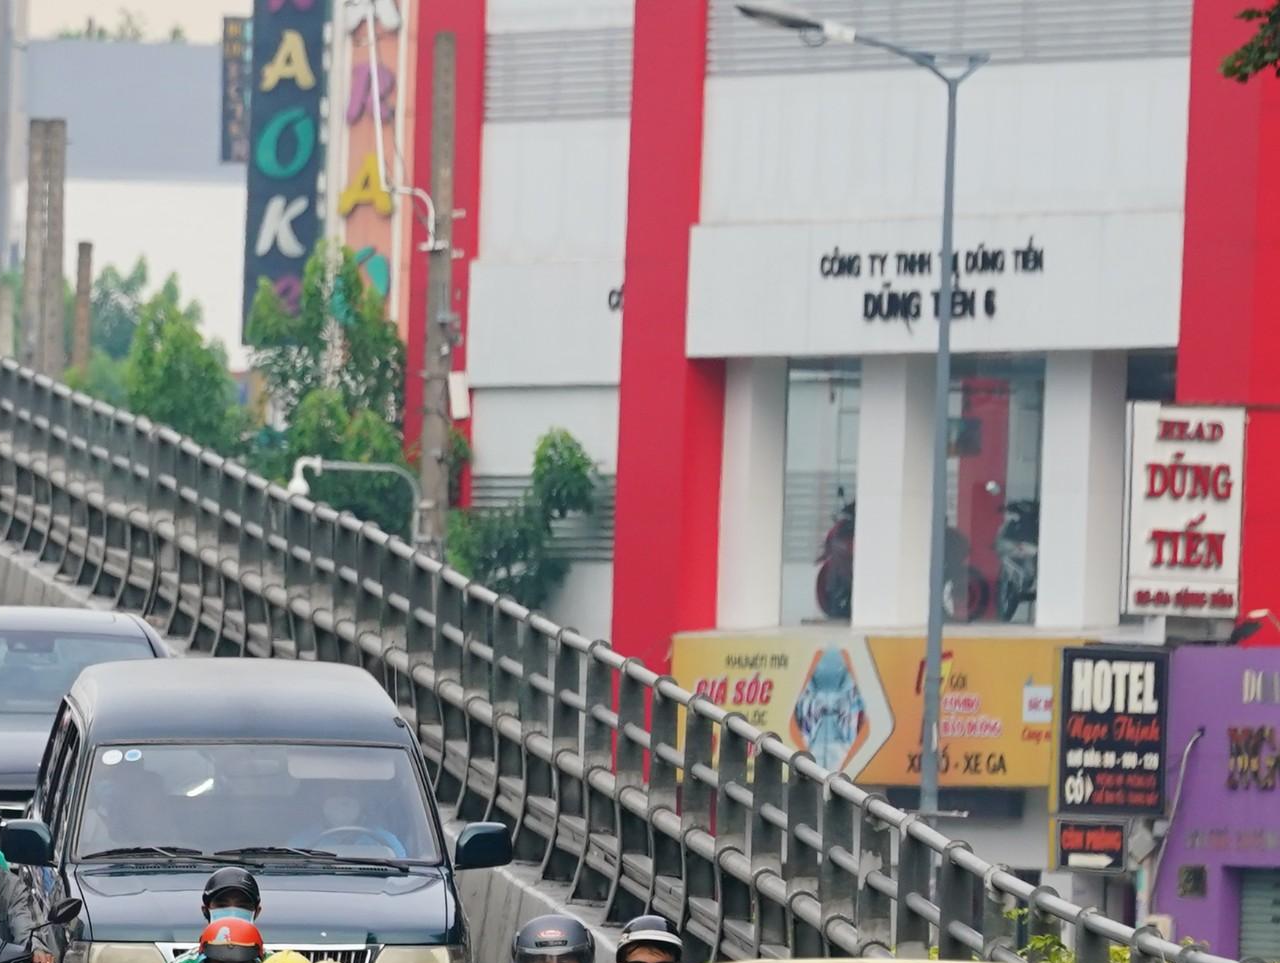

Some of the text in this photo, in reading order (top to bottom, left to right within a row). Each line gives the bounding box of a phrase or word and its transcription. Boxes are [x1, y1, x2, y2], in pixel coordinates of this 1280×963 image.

[868, 253, 889, 275] TY
[984, 289, 996, 317] 6
[1159, 420, 1224, 441] HEAD
[1149, 513, 1225, 569] TIẾN
[1071, 659, 1158, 714] HOTEL
[962, 753, 981, 775] XE
[986, 753, 1007, 774] GA
